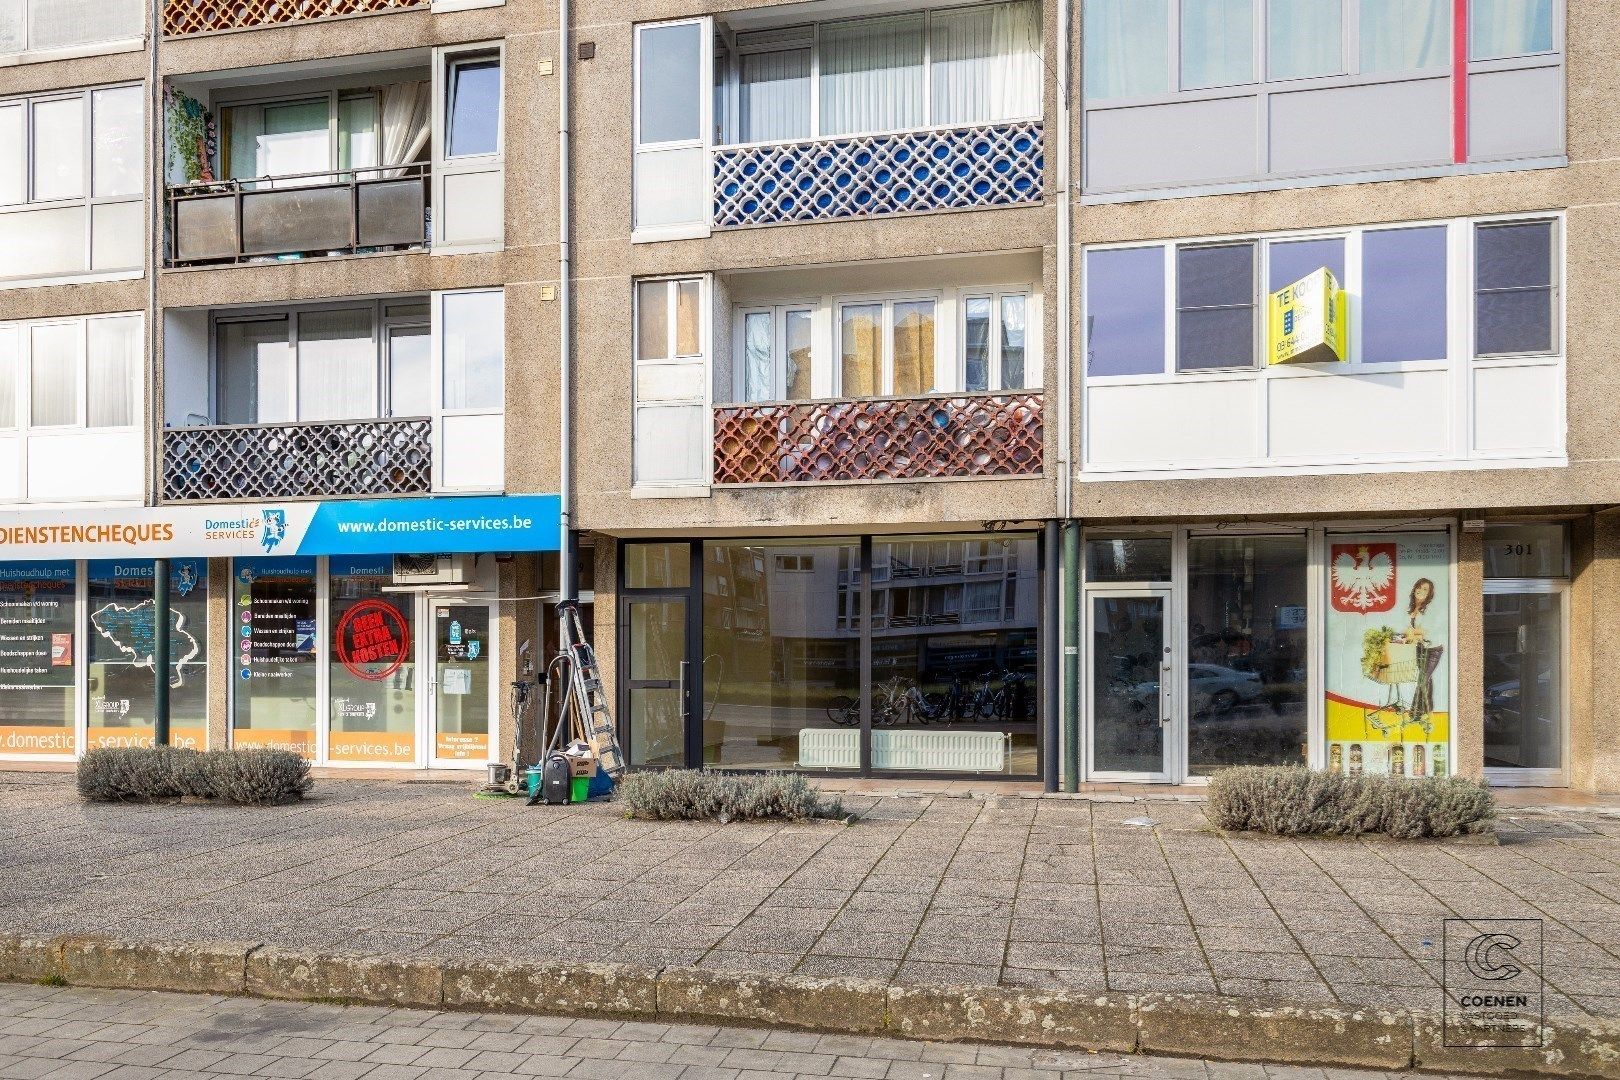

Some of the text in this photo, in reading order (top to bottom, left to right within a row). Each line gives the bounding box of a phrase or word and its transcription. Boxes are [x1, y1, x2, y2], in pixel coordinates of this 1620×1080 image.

[1276, 289, 1290, 307] TE
[337, 514, 532, 533] www.domestic-services.be
[0, 523, 173, 545] DIENSTENCHEQUES
[205, 530, 255, 540] SERVICES
[1503, 544, 1533, 556] 301
[0, 567, 70, 579] Huishoudhulp met
[114, 565, 154, 577] Domes
[352, 611, 384, 633] GEEN
[352, 625, 392, 649] EXTRA
[351, 638, 399, 664] KOSTEN
